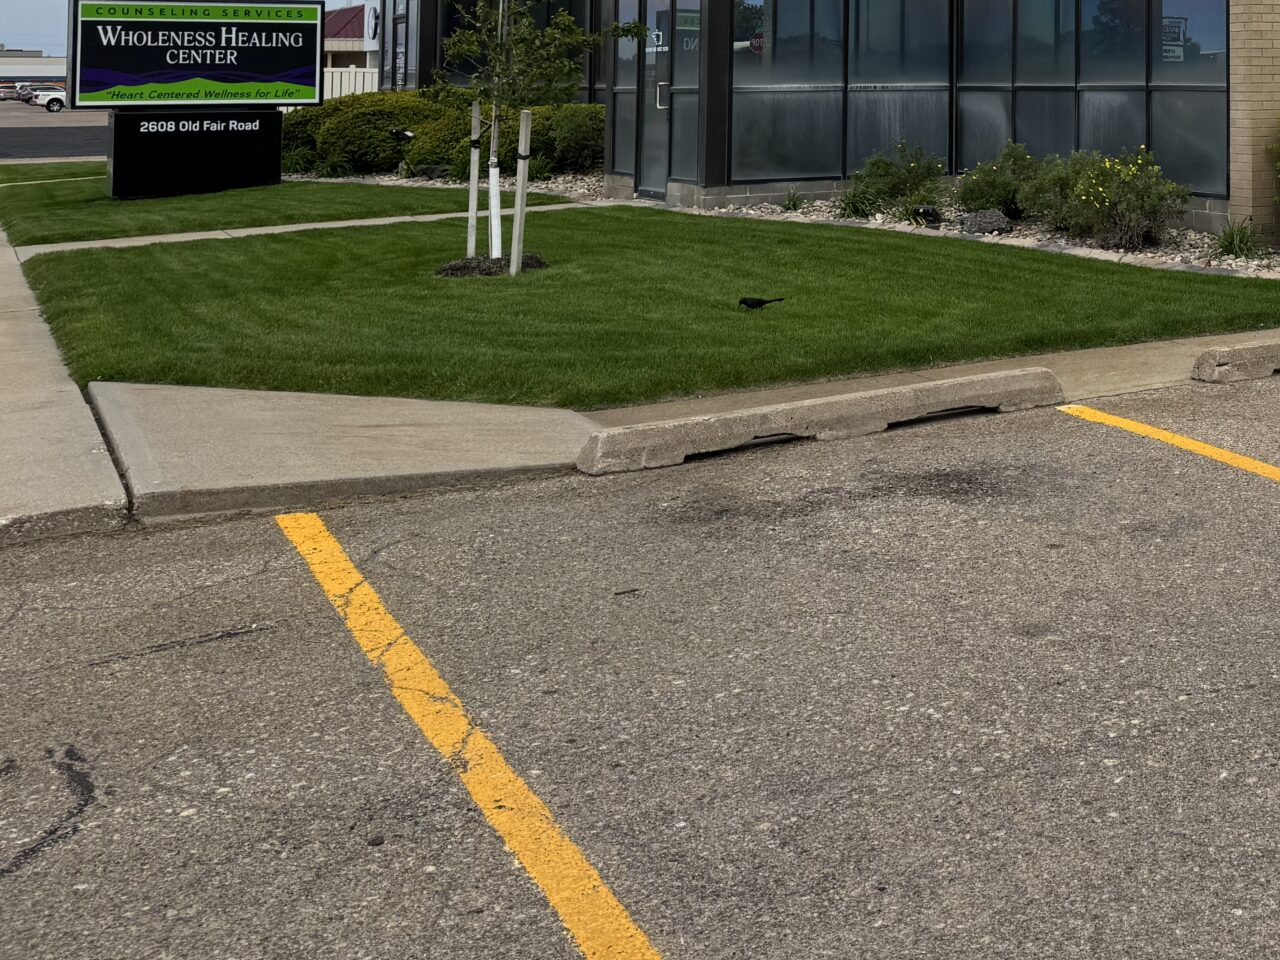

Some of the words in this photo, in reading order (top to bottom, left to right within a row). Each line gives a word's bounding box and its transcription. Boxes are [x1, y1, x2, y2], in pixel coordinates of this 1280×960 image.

[95, 6, 211, 17] COUNSELING
[222, 8, 304, 18] SERVICES
[96, 25, 216, 47] WHOLENESS
[220, 26, 304, 48] HEALING
[166, 49, 238, 65] CENTER
[106, 90, 144, 100] “Heart
[148, 89, 200, 100] Centered
[204, 89, 252, 99] Wellness
[255, 89, 270, 98] for
[274, 88, 301, 99] Life”
[140, 120, 176, 132] 2608
[179, 119, 200, 132] Old
[203, 119, 226, 131] Fair
[229, 119, 260, 131] Road
